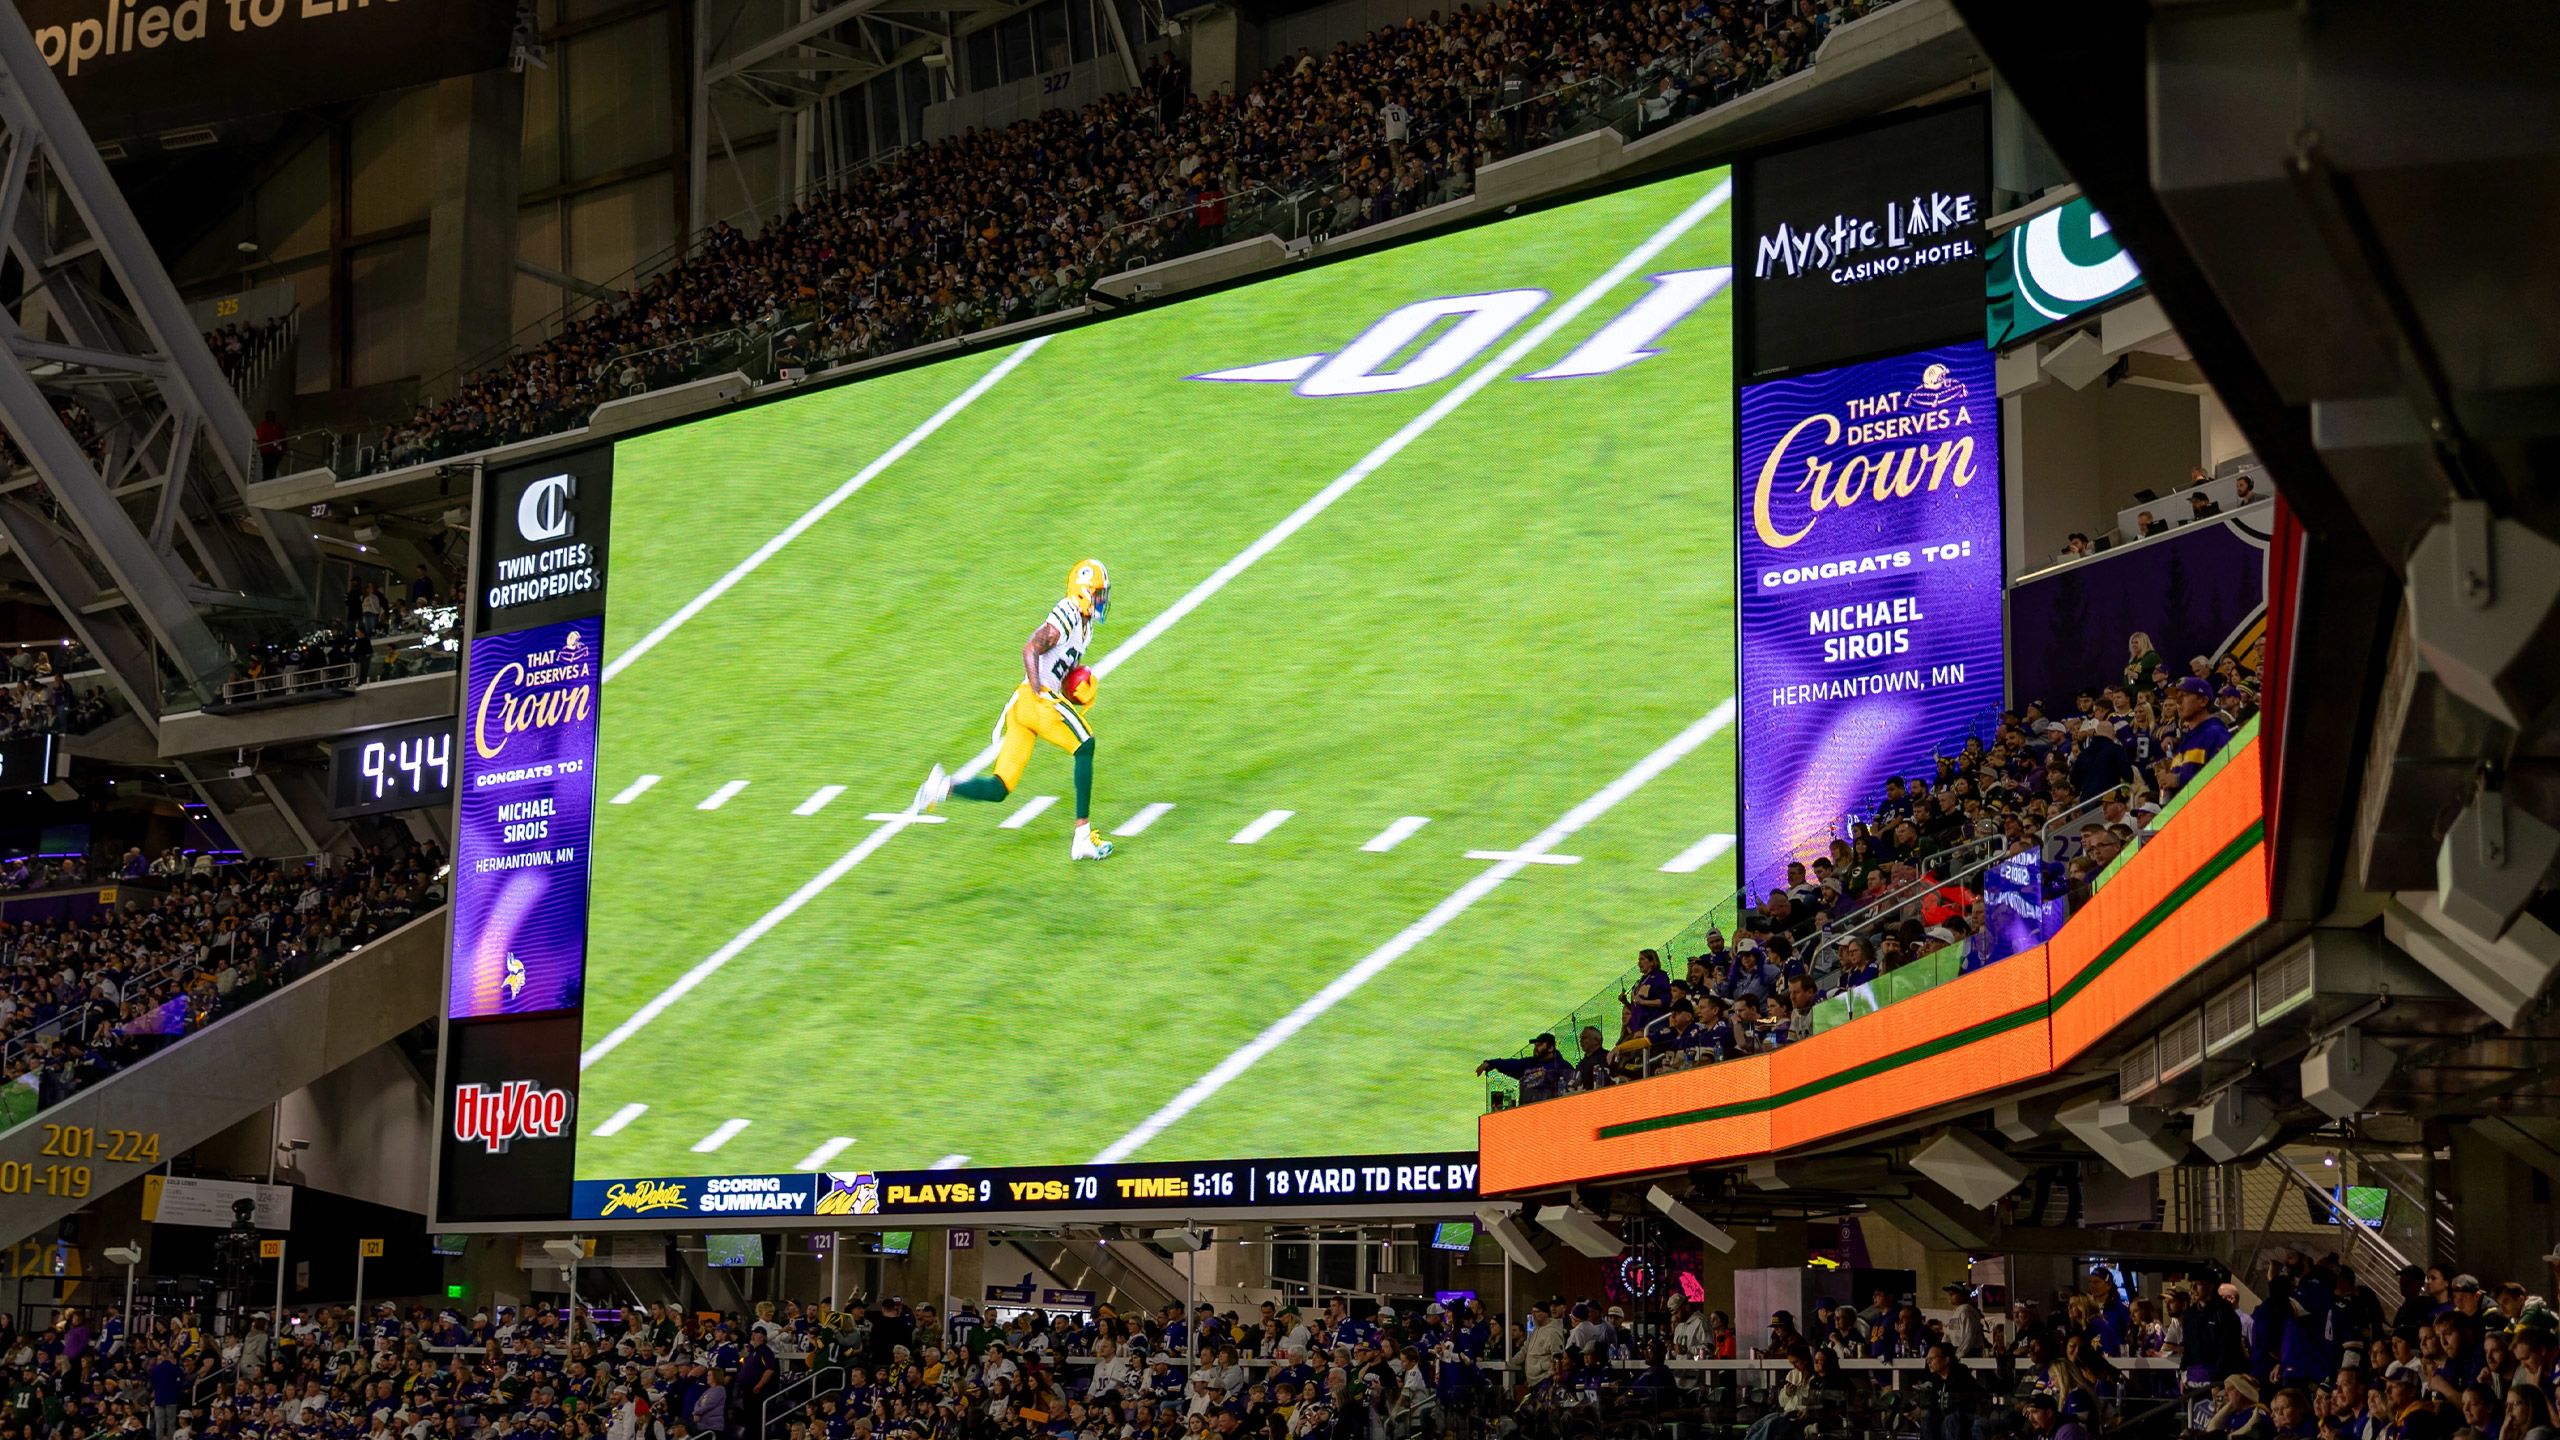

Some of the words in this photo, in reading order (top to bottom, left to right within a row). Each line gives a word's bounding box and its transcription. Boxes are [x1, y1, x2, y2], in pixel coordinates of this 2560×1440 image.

[1044, 71, 1070, 94] 327
[1755, 215, 1876, 278] Mystic
[1831, 257, 1899, 284] CASINO
[1915, 240, 1973, 265] HOTEL
[215, 298, 239, 318] 325
[1846, 391, 1902, 420] THAT
[1847, 409, 1951, 446] DESERVES
[1955, 406, 1973, 427] A
[1753, 413, 1978, 549] Crown
[311, 503, 327, 518] 327
[498, 554, 537, 581] TWIN
[540, 543, 588, 573] CITIES
[1763, 550, 1912, 588] CONGRATS
[1921, 540, 1971, 563] TO:
[489, 568, 593, 609] ORTHOPEDICS
[1809, 596, 1924, 636] MICHAEL
[527, 649, 557, 669] THAT
[1824, 628, 1909, 663] SIROIS
[526, 664, 580, 688] DESERVES
[581, 662, 590, 678] A
[1772, 669, 1925, 708] HERMANTOWN,
[1932, 663, 1965, 687] MN
[475, 661, 591, 759] Crown
[362, 733, 450, 798] 9:44
[476, 764, 553, 787] CONGRATS
[557, 759, 583, 775] TO:
[497, 797, 557, 823] MICHAEL
[503, 820, 549, 844] SIROIS
[476, 850, 554, 873] HERMANTOWN,
[556, 847, 574, 864] MN
[41, 1123, 161, 1164] 201-224
[0, 1160, 91, 1198] 01-119
[707, 1178, 780, 1193] SCORING
[887, 1184, 976, 1204] PLAYS:
[979, 1179, 991, 1202] 9
[1009, 1180, 1070, 1200] YDS:
[1074, 1176, 1097, 1200] 70
[1117, 1177, 1188, 1198] TIME:
[1193, 1171, 1233, 1196] 5:16
[1266, 1170, 1289, 1195] 18
[1294, 1167, 1356, 1194] YARD
[1361, 1167, 1390, 1192] TD
[1396, 1165, 1441, 1191] REC
[1447, 1163, 1478, 1189] BY
[699, 1192, 807, 1212] SUMMARY
[263, 1242, 278, 1255] 120
[366, 1242, 380, 1254] 121
[814, 1234, 831, 1249] 121
[953, 1232, 970, 1247] 122
[16, 1391, 31, 1409] 11
